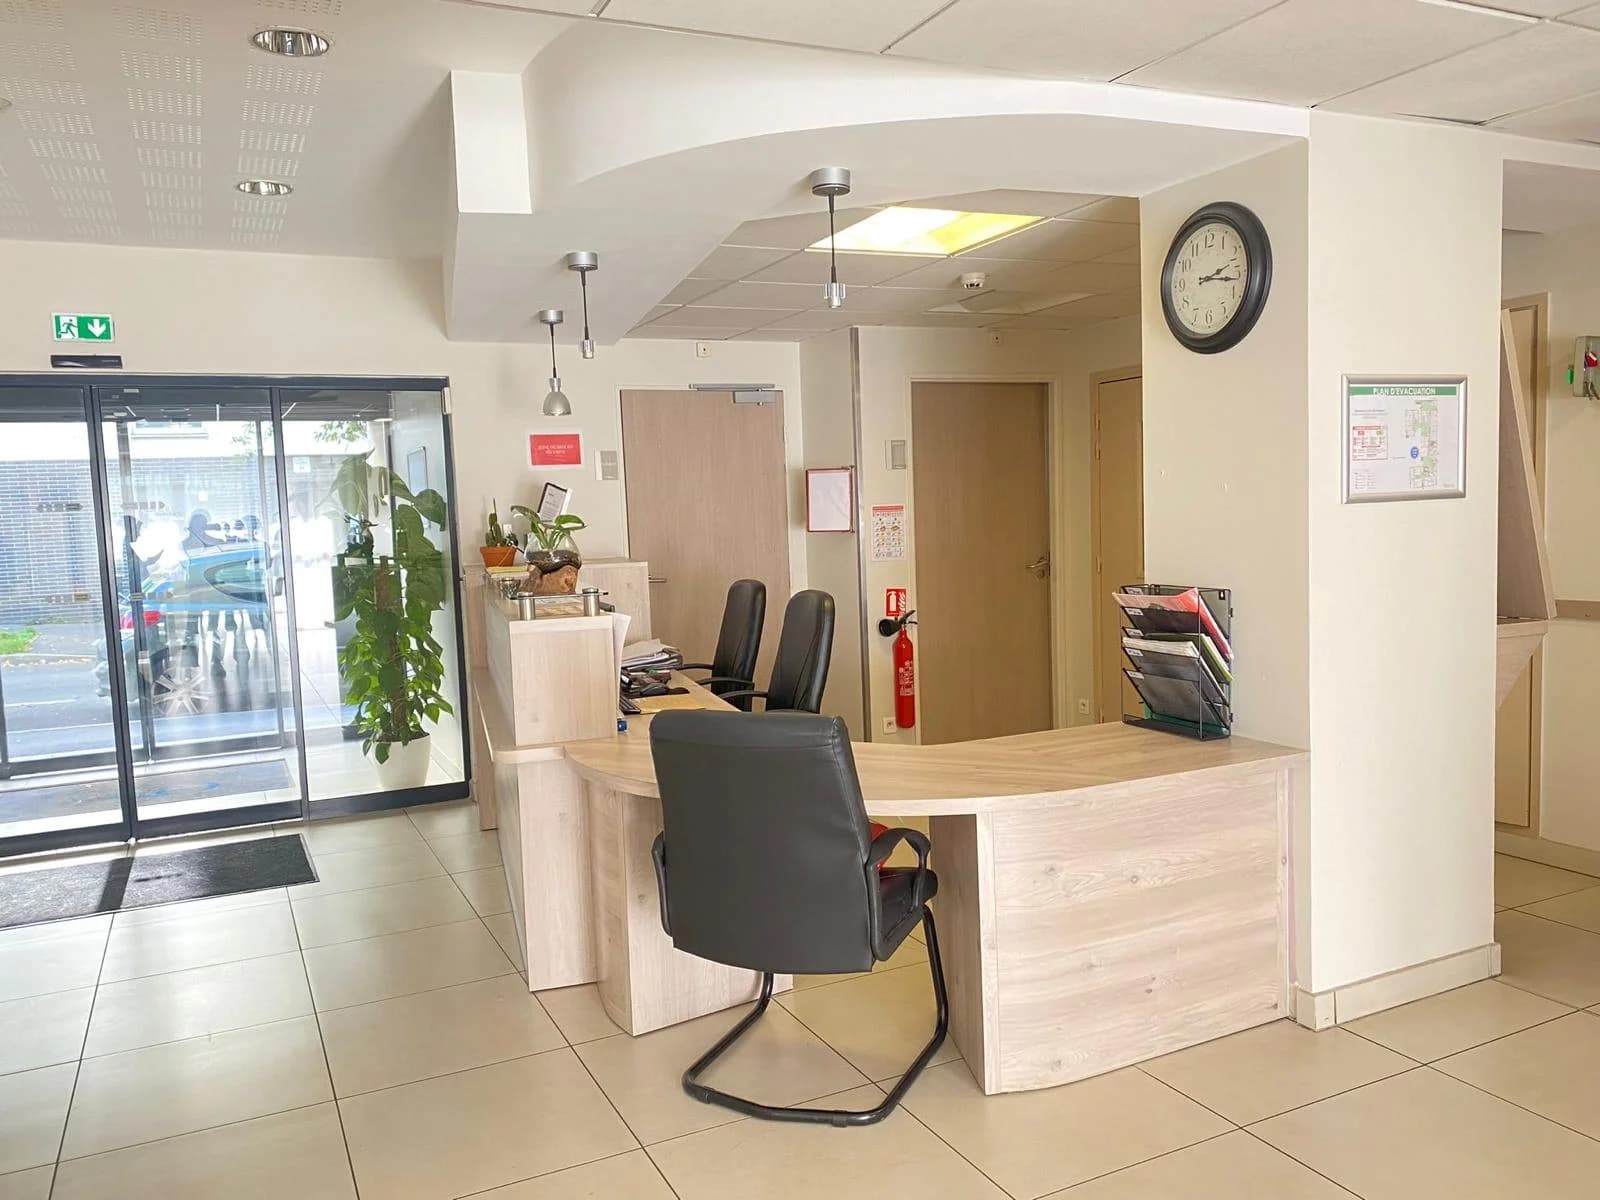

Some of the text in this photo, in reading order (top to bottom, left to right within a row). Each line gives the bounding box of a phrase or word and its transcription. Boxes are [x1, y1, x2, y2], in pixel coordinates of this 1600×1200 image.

[1204, 233, 1214, 249] 12
[1221, 235, 1225, 250] 1
[1191, 242, 1199, 258] 11
[1230, 245, 1238, 261] 2
[1182, 259, 1192, 273] 10
[1178, 279, 1186, 293] 9
[1182, 296, 1190, 309] 8
[1192, 307, 1200, 324] 7
[1205, 310, 1213, 324] 6
[1373, 387, 1389, 396] PLAN
